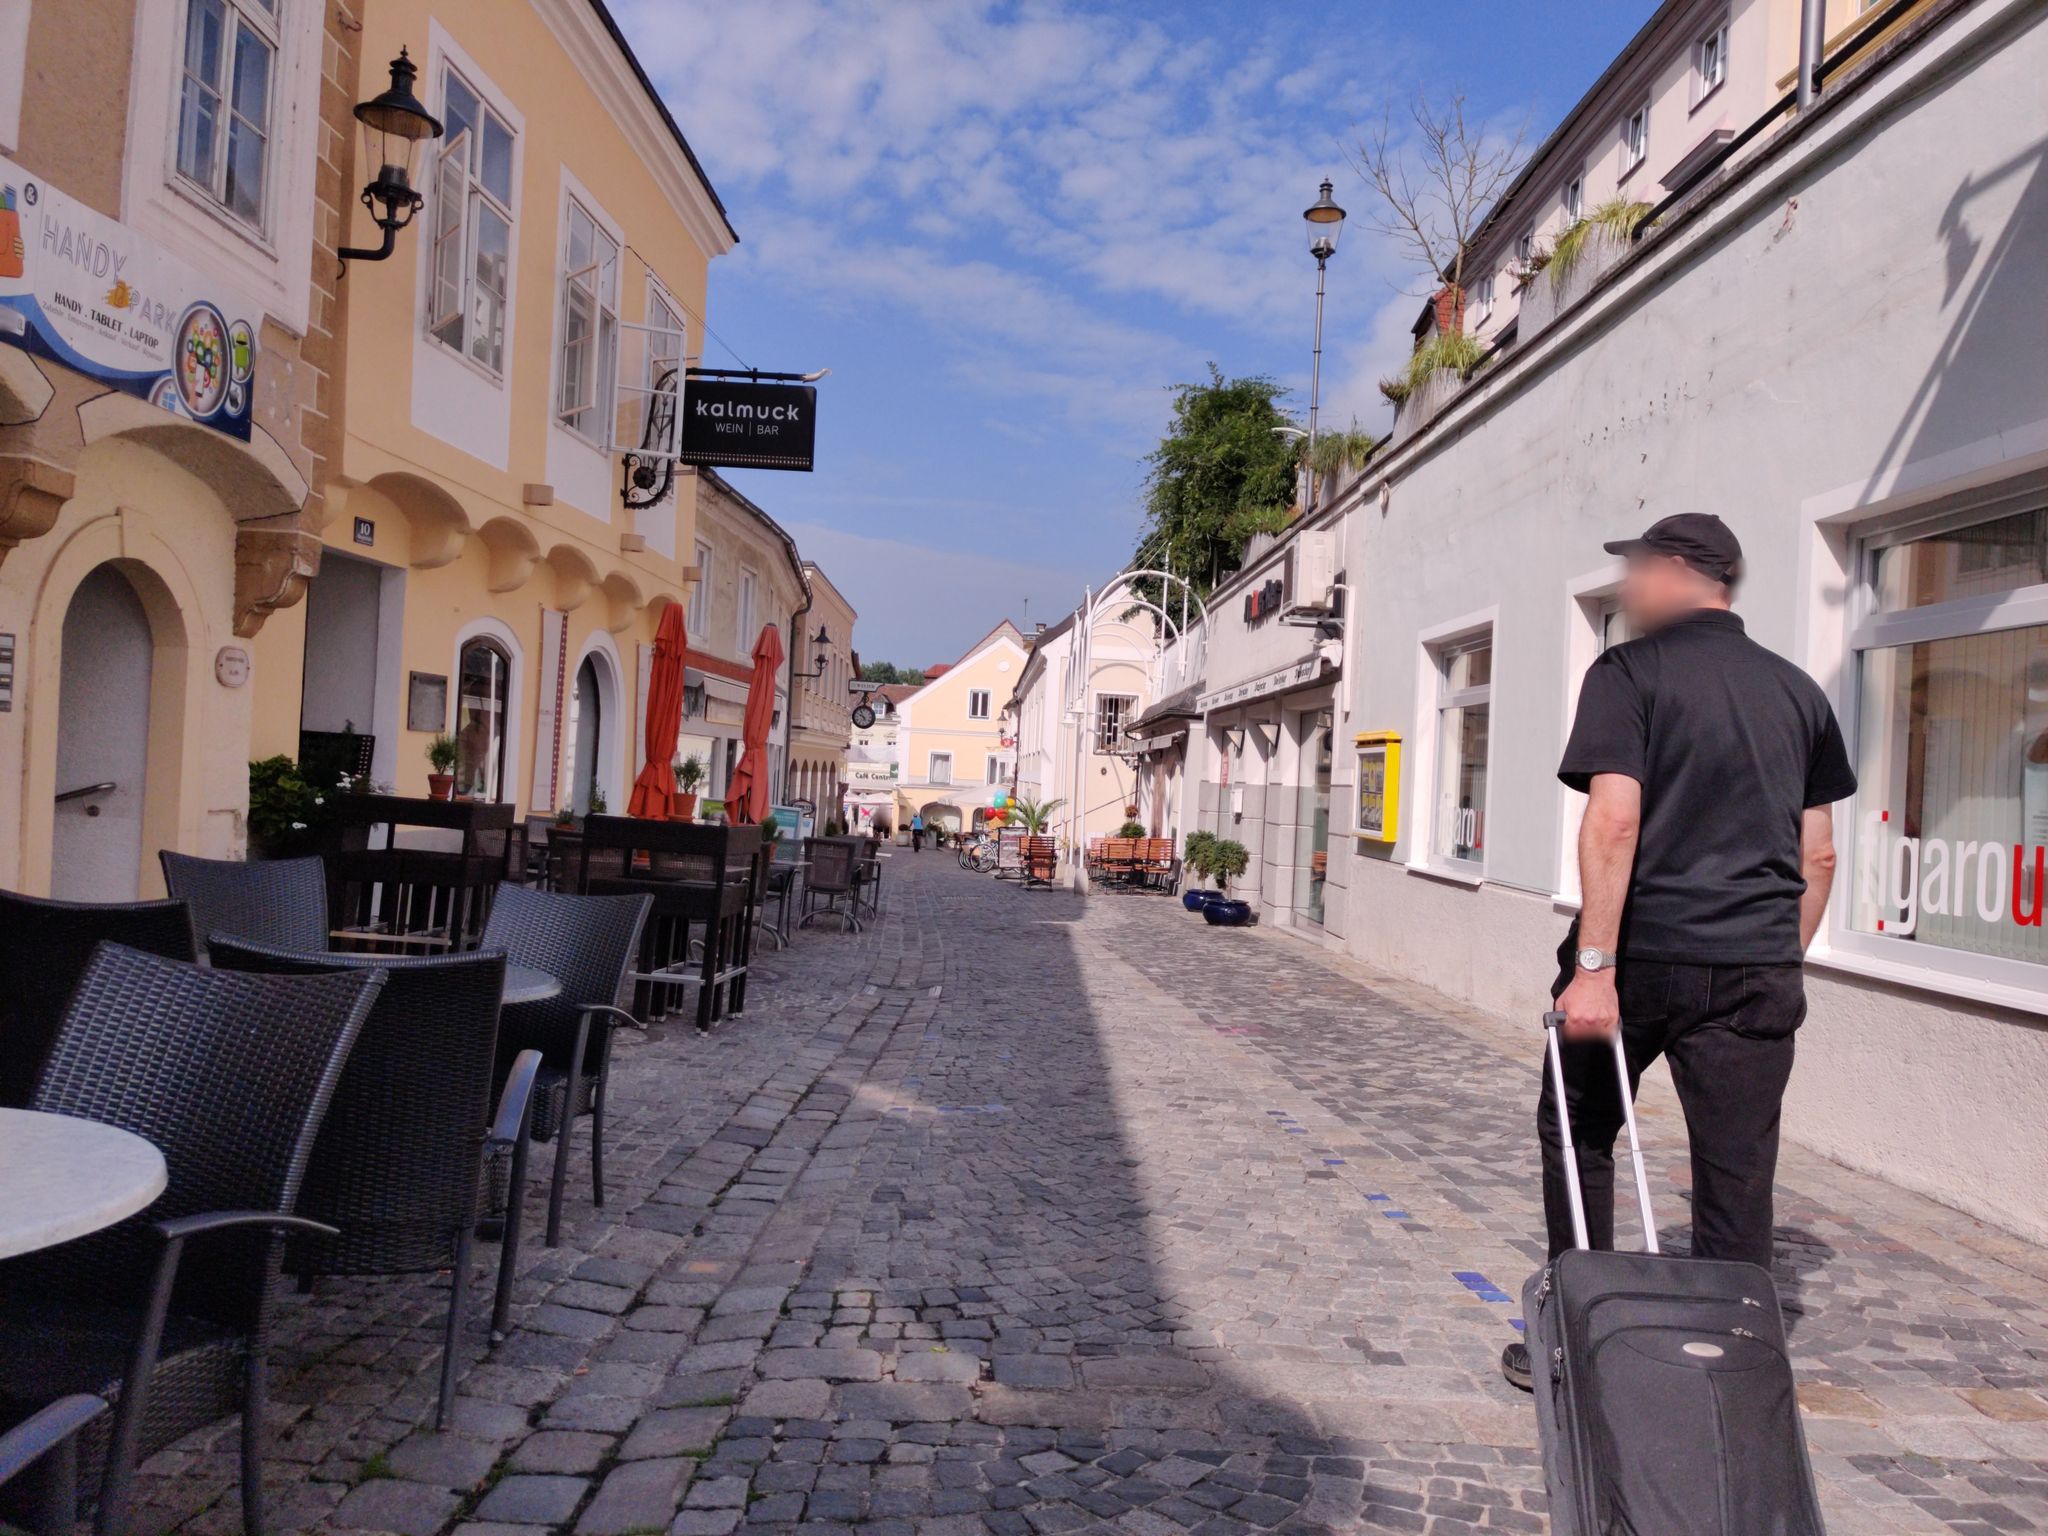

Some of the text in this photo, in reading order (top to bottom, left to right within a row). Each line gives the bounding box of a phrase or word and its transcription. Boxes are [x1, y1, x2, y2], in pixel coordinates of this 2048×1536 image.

[43, 214, 127, 283] HANDY
[54, 291, 83, 314] HANDY
[91, 309, 123, 332] TABLET
[129, 327, 159, 349] LAPTOP
[128, 288, 176, 336] PARK
[696, 399, 800, 421] kalmuck
[715, 423, 779, 436] WEIN BAR
[360, 522, 371, 535] 10
